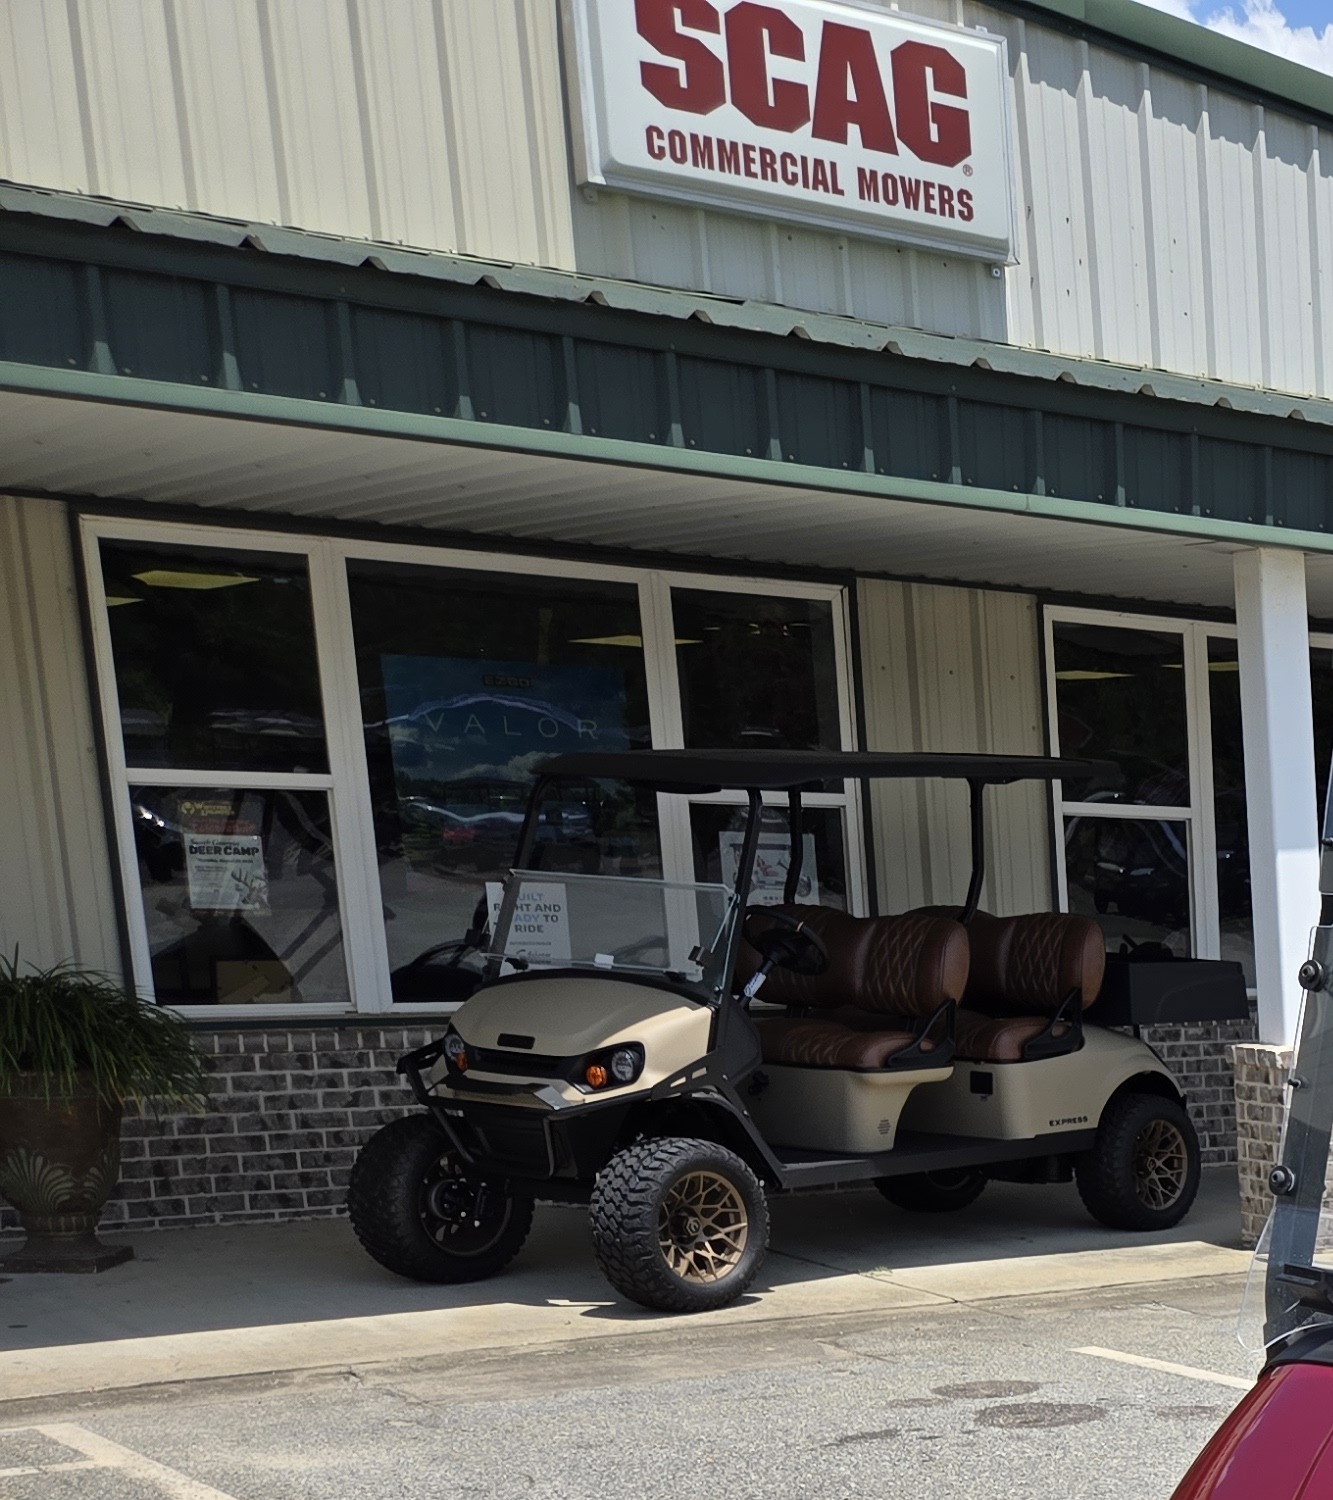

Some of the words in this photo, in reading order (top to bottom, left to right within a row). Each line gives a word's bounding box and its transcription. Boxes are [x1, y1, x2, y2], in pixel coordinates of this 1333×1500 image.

[634, 0, 972, 167] SCAG
[646, 124, 845, 196] COMMERCIAL
[857, 166, 975, 222] MOWERS
[424, 712, 599, 740] VALOR
[189, 845, 222, 856] DEER
[223, 845, 260, 857] CAMP
[493, 903, 531, 912] RHT
[534, 903, 562, 913] AND
[543, 914, 559, 923] TO
[514, 924, 545, 934] RIDE
[1048, 1115, 1089, 1127] EXPRESS
